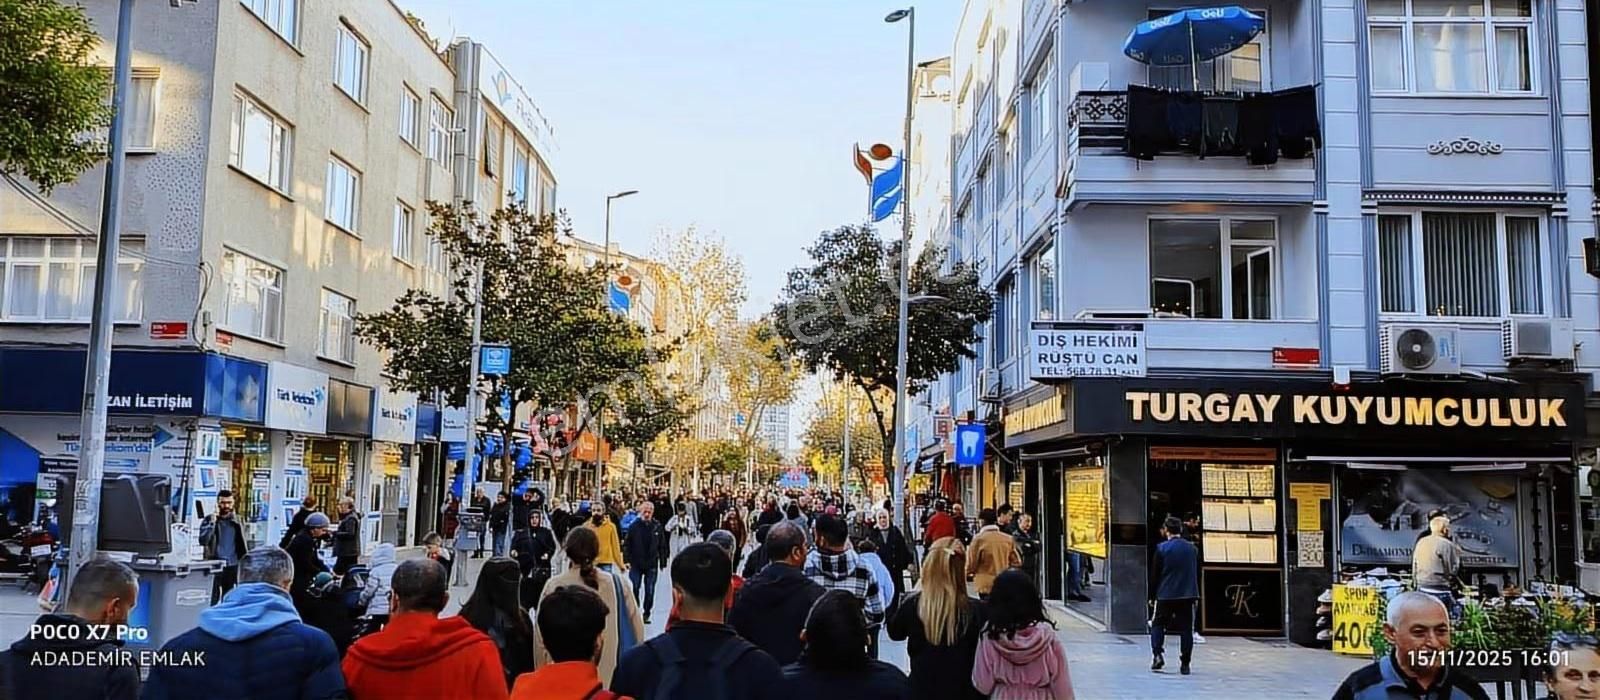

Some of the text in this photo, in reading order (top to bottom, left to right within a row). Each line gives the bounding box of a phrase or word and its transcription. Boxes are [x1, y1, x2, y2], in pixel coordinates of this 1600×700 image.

[1038, 332, 1137, 349] DİŞ HEKİMİ
[1038, 351, 1138, 366] RÜŞTÜ CAN
[1041, 367, 1063, 376] TEL:
[135, 393, 193, 411] İLETİŞİM
[1126, 391, 1567, 427] TURGAY KUYUMCULUK
[1344, 587, 1368, 601] SPOR
